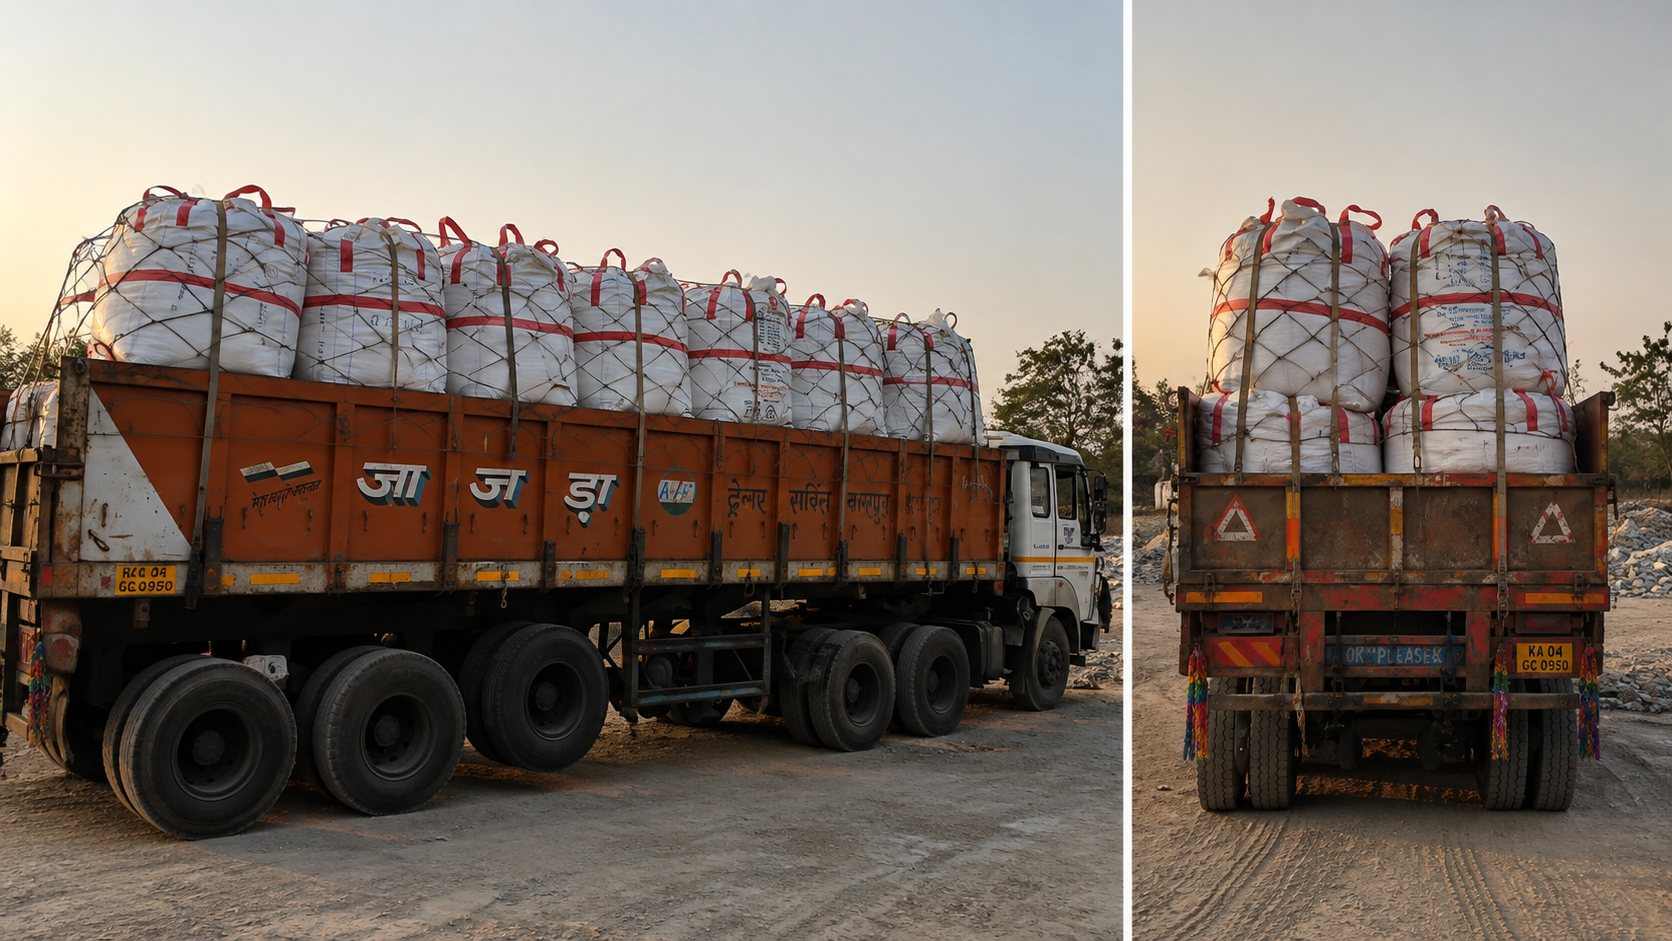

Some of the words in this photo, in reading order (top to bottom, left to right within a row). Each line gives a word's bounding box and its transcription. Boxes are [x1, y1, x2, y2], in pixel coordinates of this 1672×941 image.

[1345, 646, 1365, 664] OK
[1528, 645, 1544, 657] KA
[1547, 645, 1563, 657] 04
[1522, 659, 1538, 671] GC
